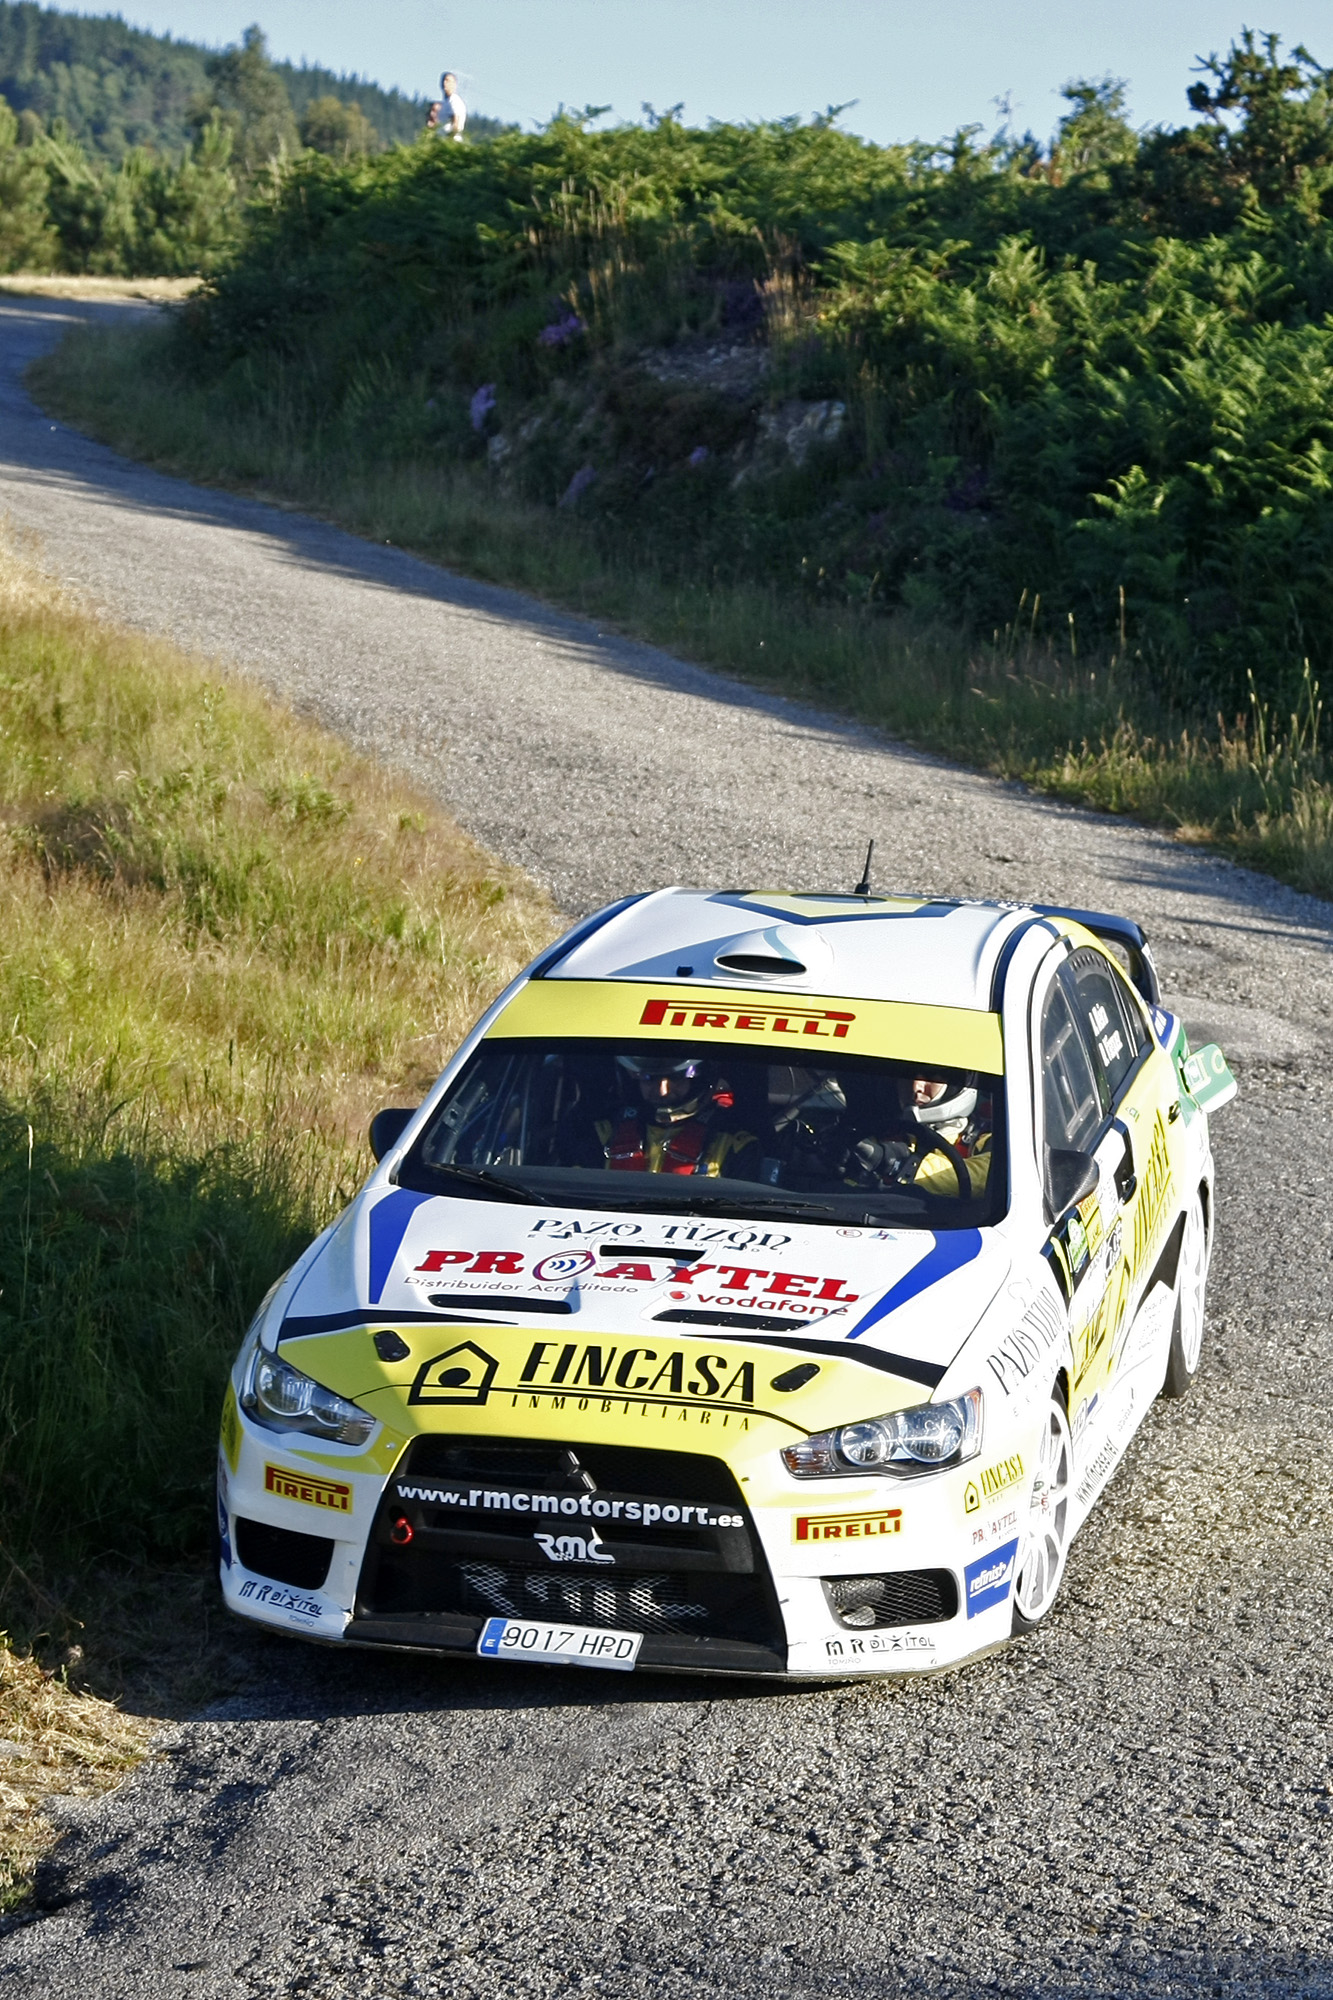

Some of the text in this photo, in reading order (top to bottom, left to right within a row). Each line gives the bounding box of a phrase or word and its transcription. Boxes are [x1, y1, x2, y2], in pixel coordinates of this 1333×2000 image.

[639, 999, 856, 1038] PIRELLI
[529, 1219, 642, 1237] PAZO
[404, 1276, 638, 1294] Distribuidor Acreditado
[697, 1293, 849, 1316] vodafone
[519, 1342, 754, 1403] FINCASA
[511, 1394, 750, 1431] INMOBILIARIA
[265, 1465, 350, 1510] PIRELLI
[980, 1453, 1024, 1496] FINCASA
[397, 1485, 744, 1529] www.rmcmotorsport.es
[796, 1508, 902, 1541] PIRELLI
[970, 1561, 1007, 1593] refinish
[504, 1626, 574, 1652] 9017
[578, 1634, 634, 1659] HPD
